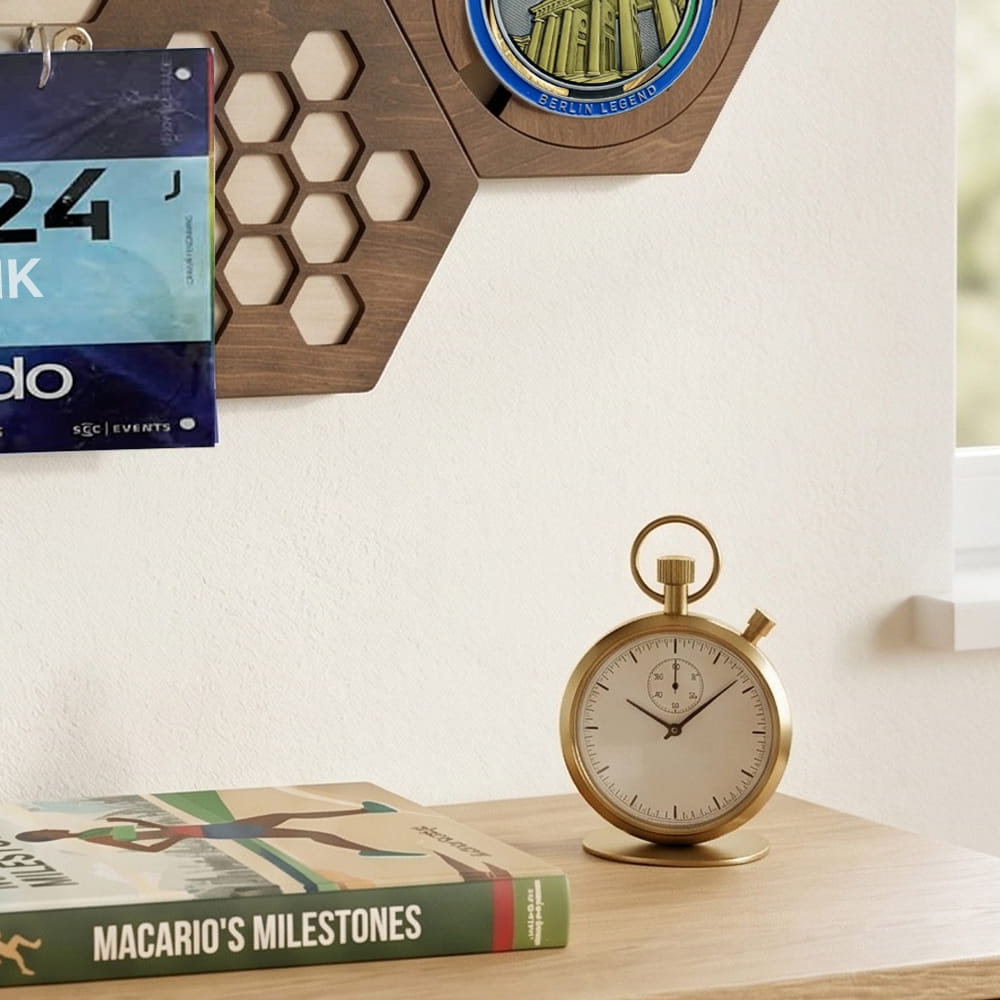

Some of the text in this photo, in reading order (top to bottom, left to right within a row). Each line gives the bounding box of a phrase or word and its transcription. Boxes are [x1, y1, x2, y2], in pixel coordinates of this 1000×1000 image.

[537, 85, 657, 114] BERLIN LEGEND
[164, 169, 181, 201] J
[112, 422, 171, 433] EVENTS
[93, 904, 423, 962] MACARIO'S MILESTONES
